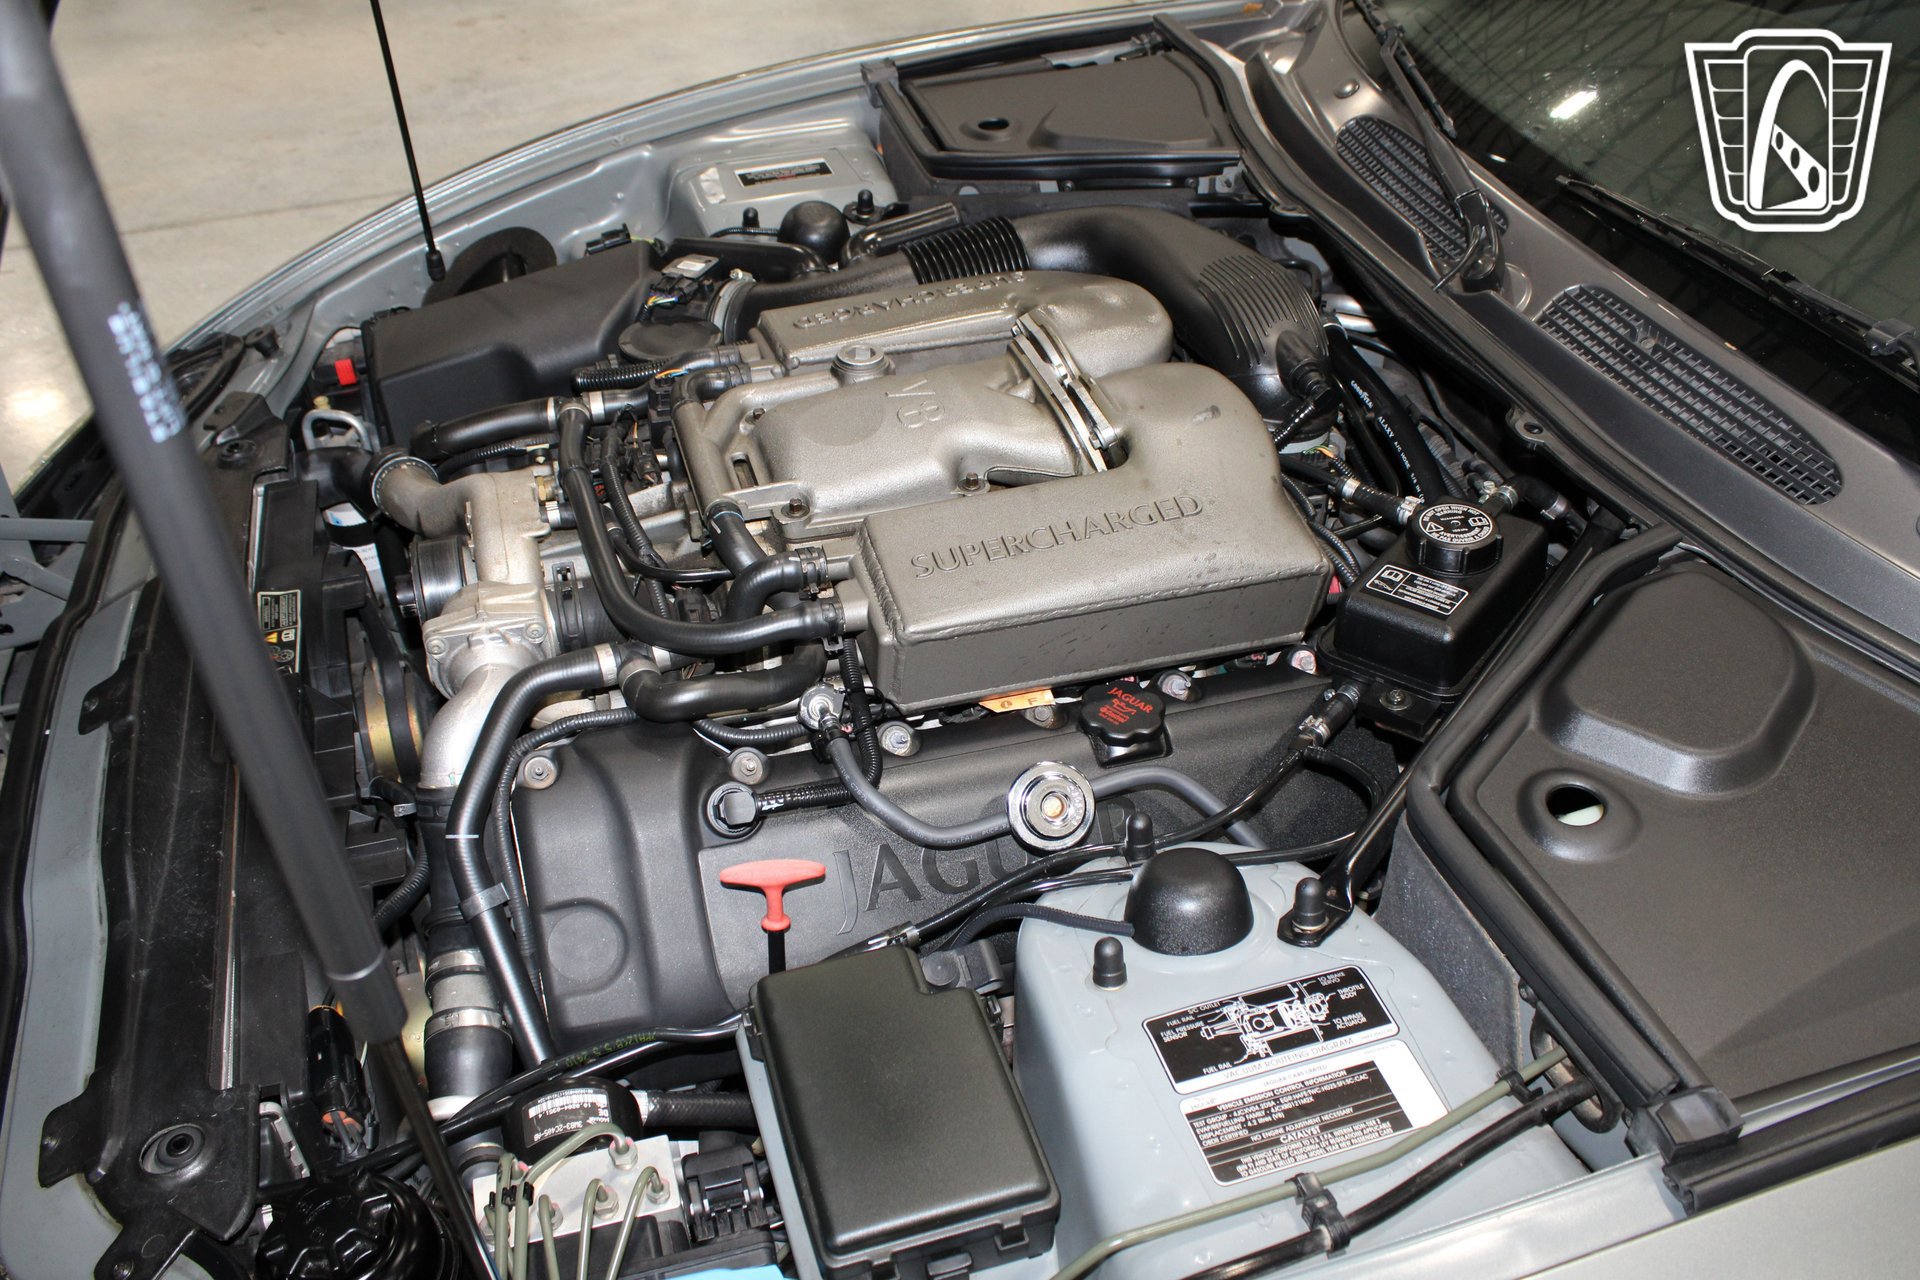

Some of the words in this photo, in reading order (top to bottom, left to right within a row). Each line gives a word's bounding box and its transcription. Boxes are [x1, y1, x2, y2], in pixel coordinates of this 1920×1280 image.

[793, 271, 1026, 330] SUPERCHARGED
[883, 376, 945, 430] V8
[1377, 415, 1395, 439] ALAXY
[911, 493, 1204, 580] SUPERCHARGED
[1107, 687, 1153, 714] JAGUAR
[1159, 1028, 1175, 1036] FUEL
[1174, 1020, 1205, 1032] PRESSURE
[1165, 1018, 1181, 1026] FUEL
[1162, 1031, 1188, 1042] SENSOR
[1202, 1065, 1218, 1074] FUEL
[1217, 1061, 1232, 1070] RAIL
[1222, 1063, 1262, 1079] VACUUM
[1263, 1049, 1309, 1067] ROUTEING
[1309, 1036, 1354, 1054] DIAGRAM
[1216, 1098, 1244, 1111] VEHICLE
[1242, 1090, 1274, 1104] EMISSION
[1272, 1081, 1304, 1095] CONTROL
[1303, 1069, 1347, 1086] INFORMATION
[1192, 1119, 1207, 1128] TEST
[1205, 1113, 1228, 1124] GROUP
[1198, 1123, 1243, 1141] DISPLACEMENT
[1250, 1134, 1262, 1142] NO
[1261, 1127, 1285, 1138] ENGINE
[1284, 1116, 1322, 1132] ADJUSTMENT
[1320, 1106, 1355, 1121] NECESSARY
[1278, 1125, 1322, 1144] CATALYST
